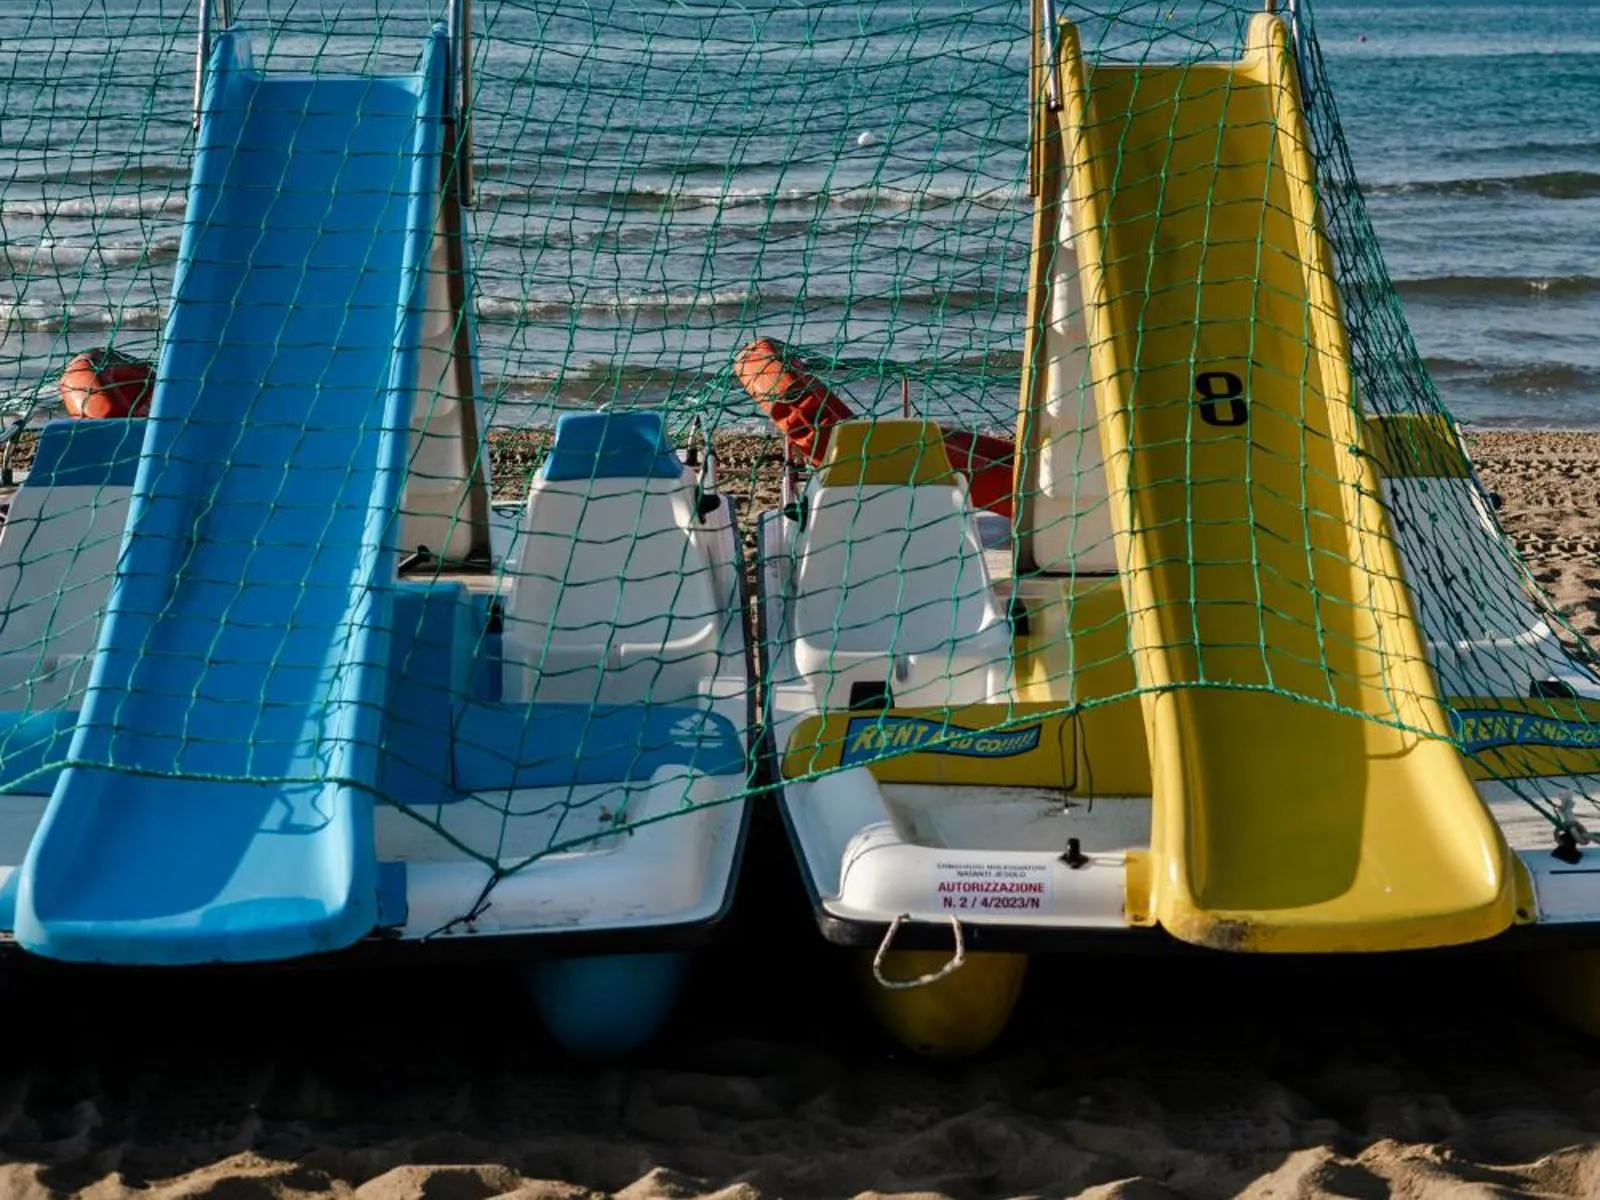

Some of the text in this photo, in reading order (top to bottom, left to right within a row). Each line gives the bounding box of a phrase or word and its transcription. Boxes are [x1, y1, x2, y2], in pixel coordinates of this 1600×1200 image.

[1196, 371, 1248, 427] 8
[938, 881, 1045, 894] AUTORIZZAZIONE
[943, 896, 957, 909] N.
[959, 896, 968, 909] 2
